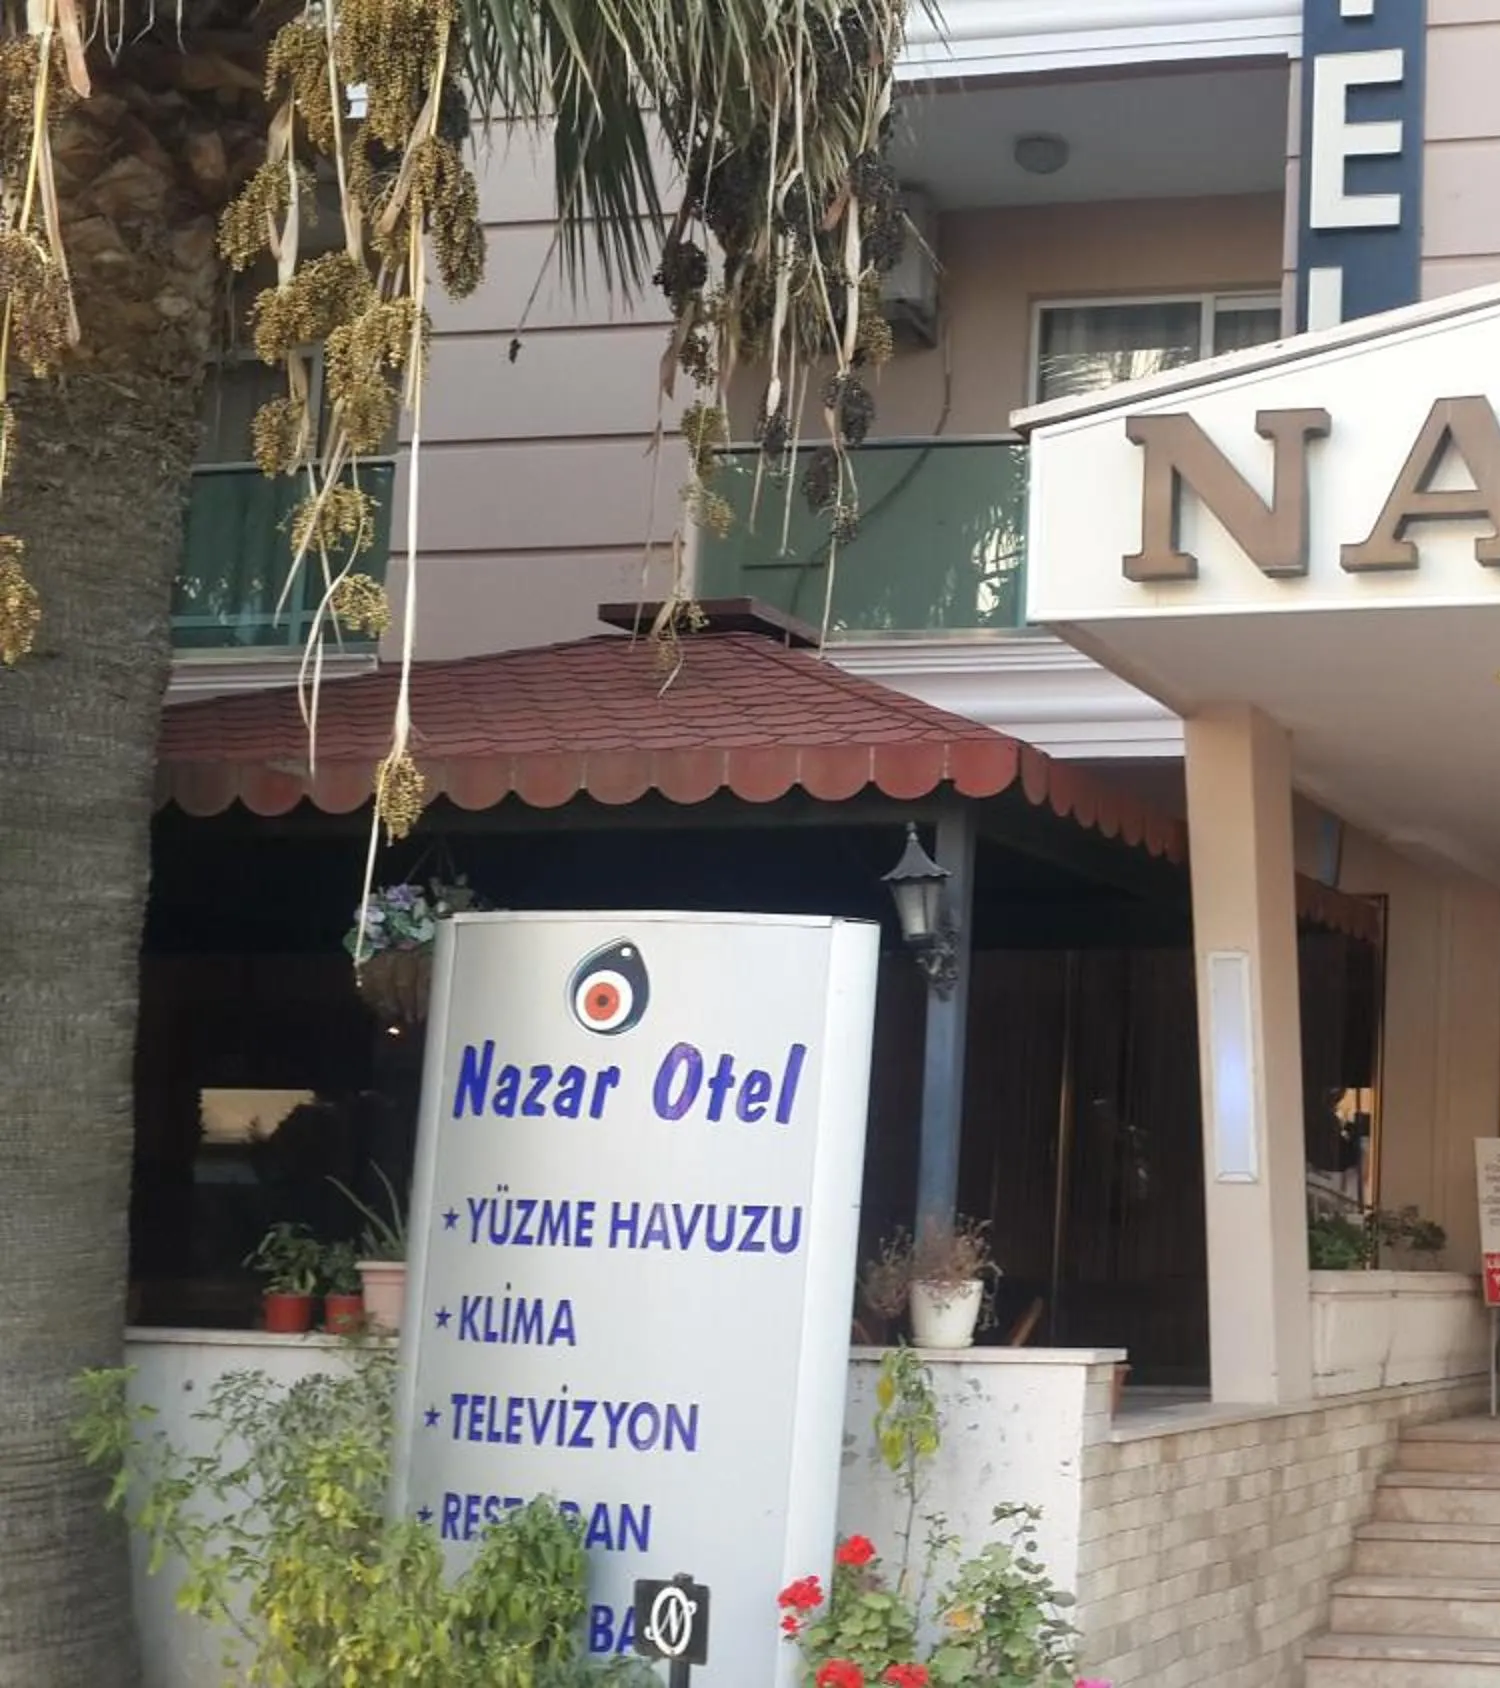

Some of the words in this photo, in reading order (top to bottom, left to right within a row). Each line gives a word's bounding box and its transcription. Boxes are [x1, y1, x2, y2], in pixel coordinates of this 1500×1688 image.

[453, 1039, 620, 1119] Nazar
[652, 1042, 807, 1124] Otel
[467, 1184, 595, 1247] YÜZME
[608, 1203, 802, 1254] HAVUZU
[458, 1282, 577, 1346] KLİMA
[451, 1385, 699, 1451] TELEVİZYON
[441, 1492, 652, 1552] RESRAN
